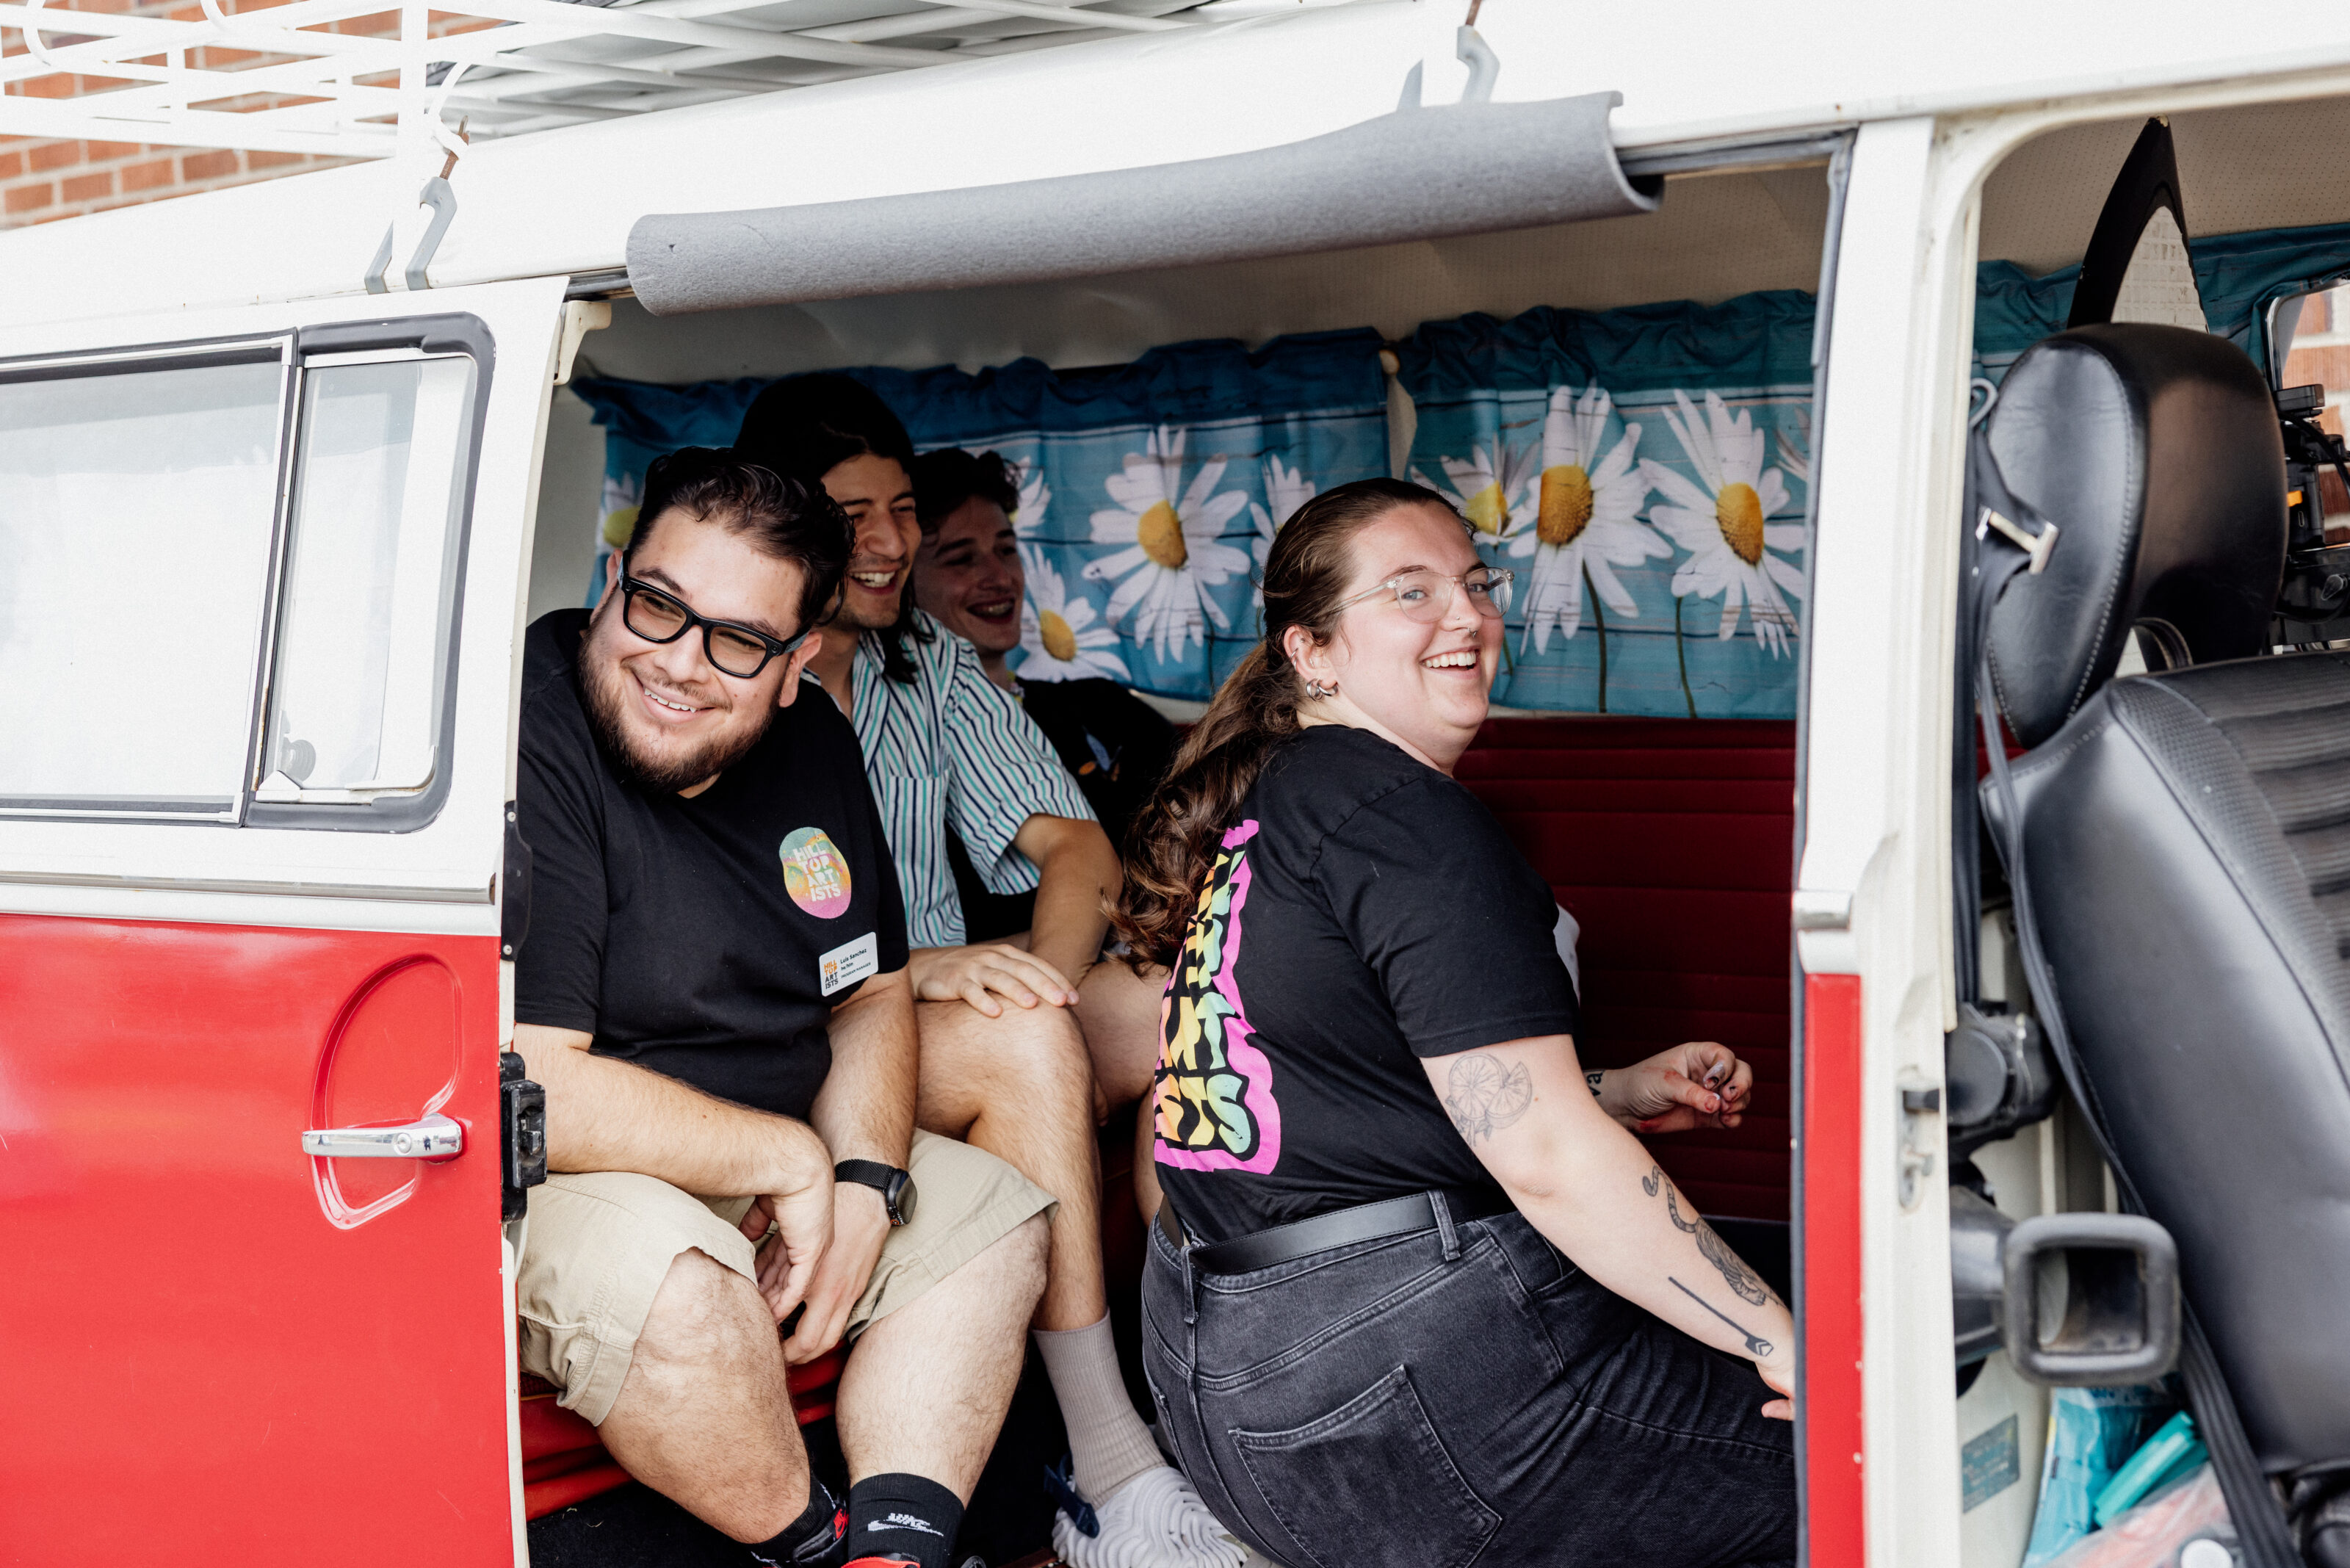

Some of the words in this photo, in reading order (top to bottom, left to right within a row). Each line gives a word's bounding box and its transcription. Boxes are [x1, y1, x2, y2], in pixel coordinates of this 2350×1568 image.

[793, 843, 826, 861] HILL
[798, 856, 830, 874] TOP
[806, 869, 834, 888] ART
[810, 884, 841, 902] ISTS
[850, 948, 867, 960] Sanchez
[824, 959, 837, 970] HILL
[824, 966, 838, 976] TOP
[825, 972, 838, 983] ART
[825, 978, 839, 989] ISTS
